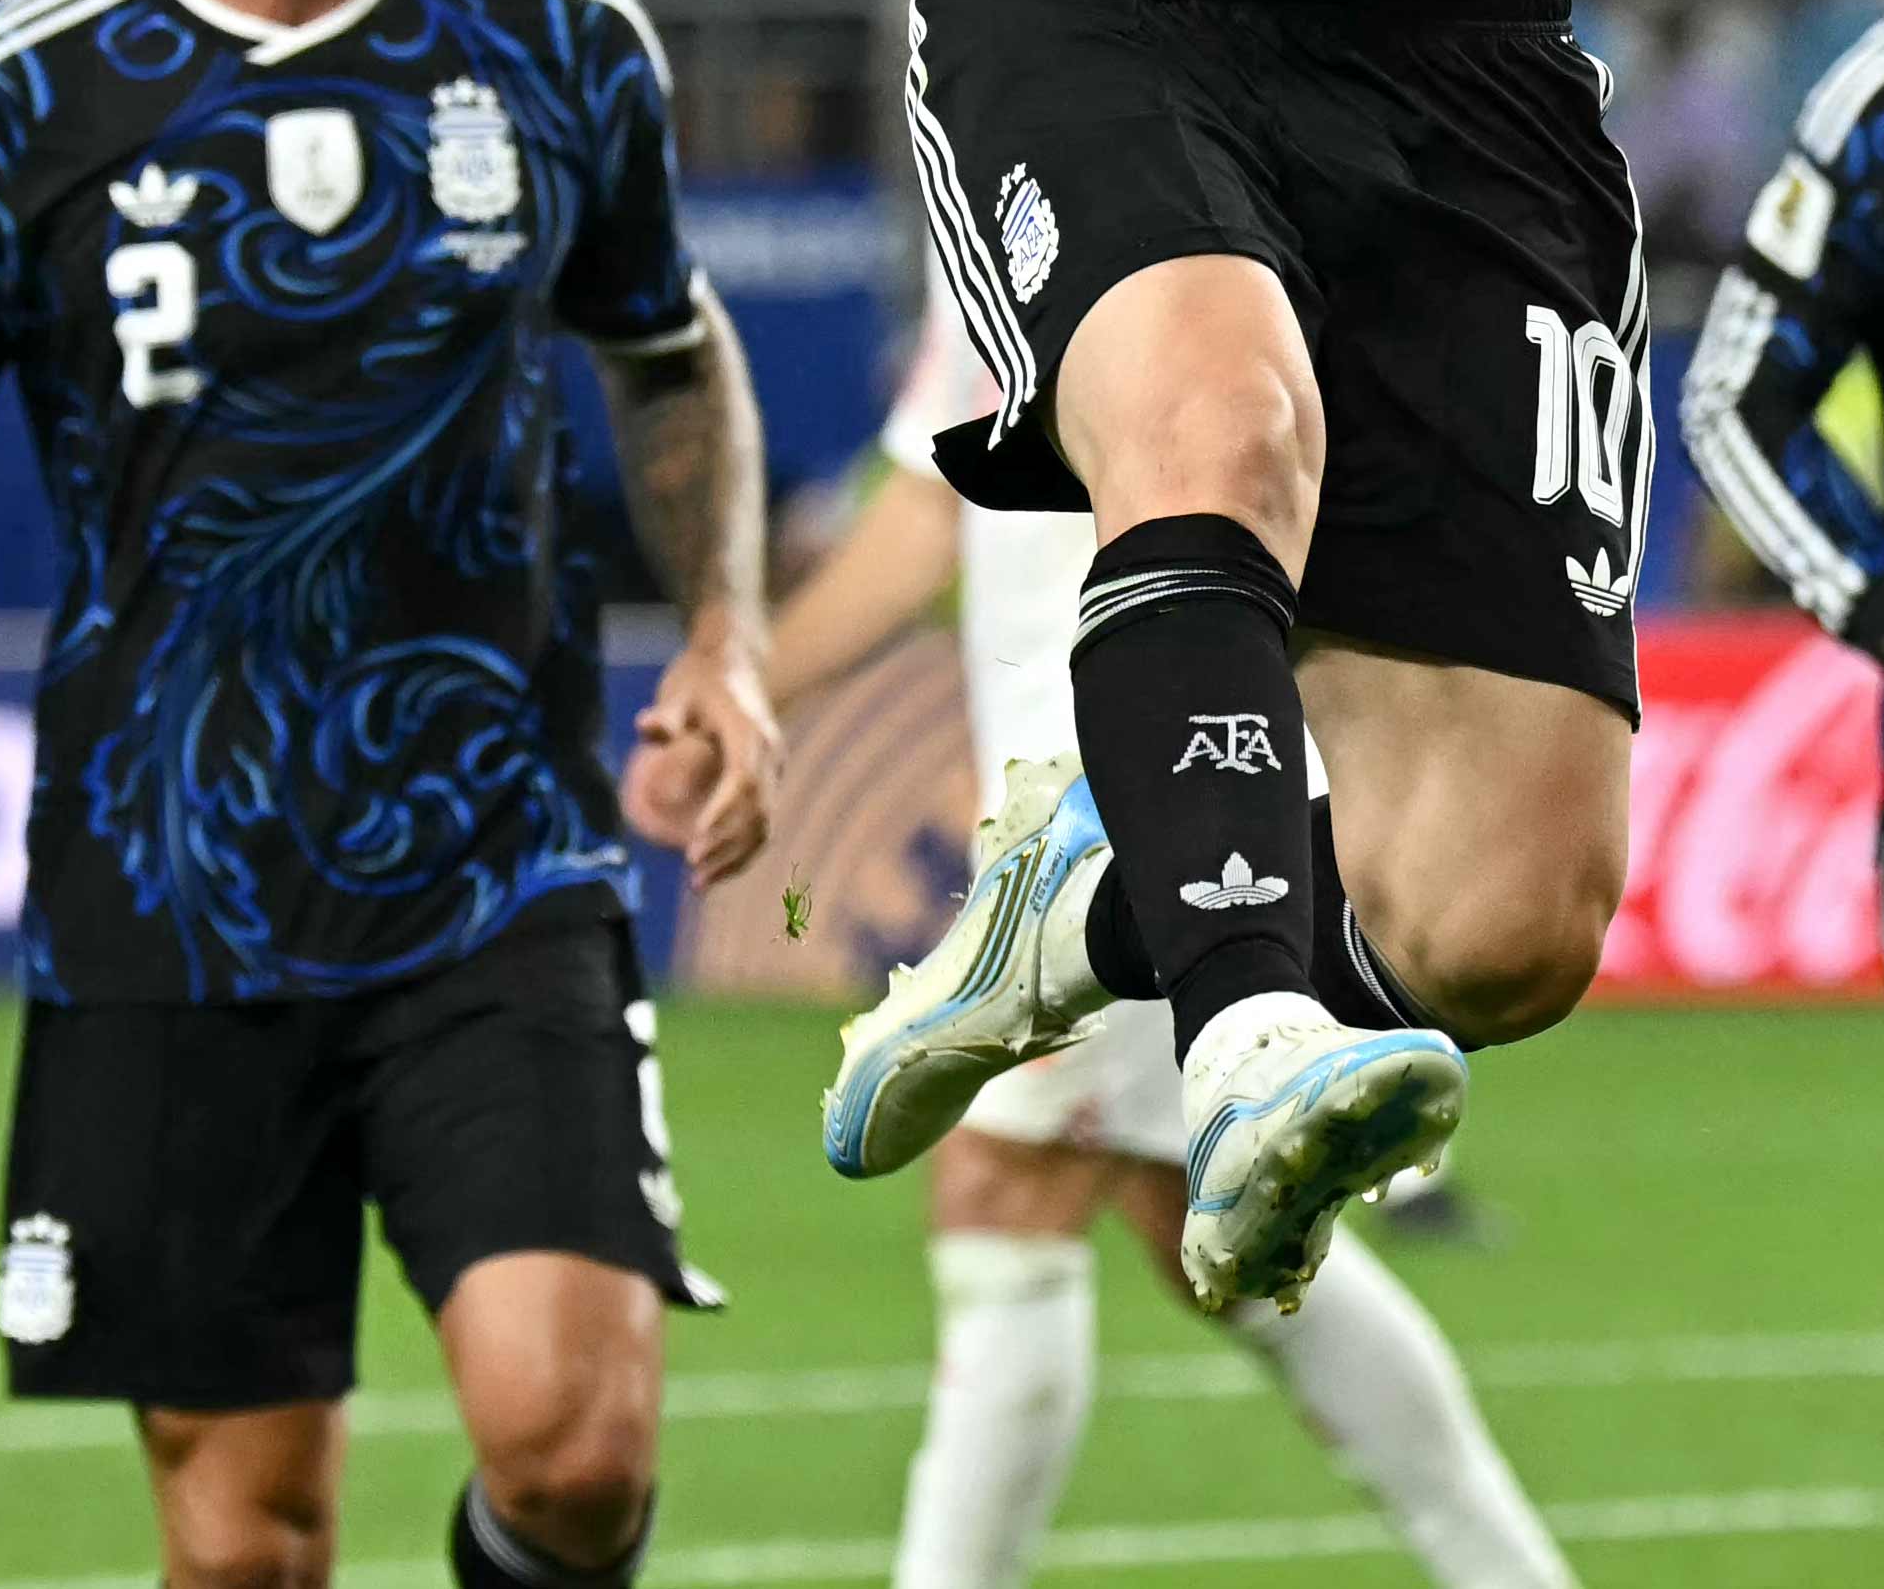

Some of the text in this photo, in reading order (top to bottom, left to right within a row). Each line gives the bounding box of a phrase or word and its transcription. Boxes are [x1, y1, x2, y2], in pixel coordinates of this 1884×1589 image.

[105, 240, 205, 409] 2
[1526, 304, 1632, 528] 10
[1173, 713, 1281, 774] AFA
